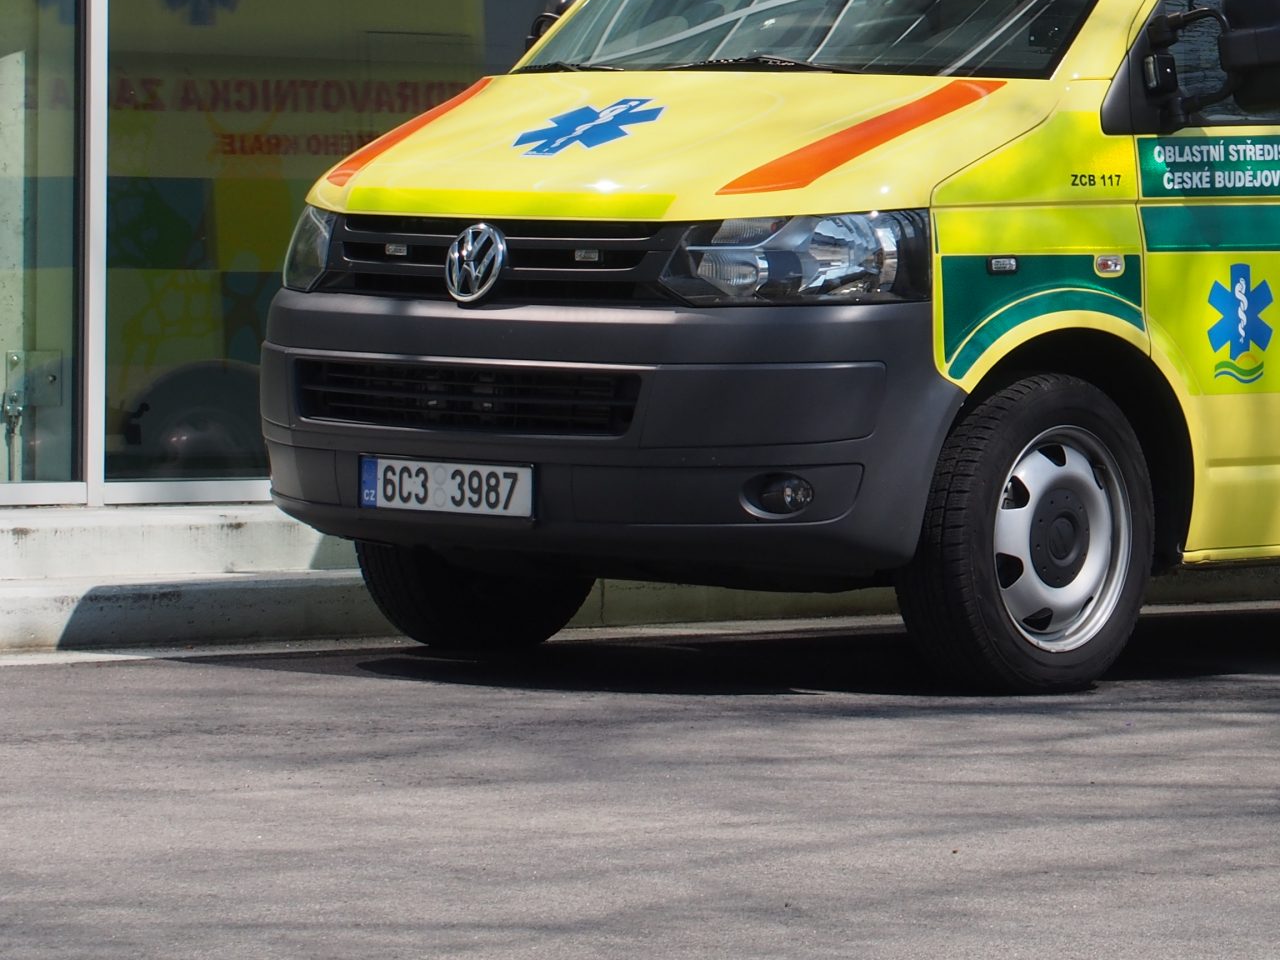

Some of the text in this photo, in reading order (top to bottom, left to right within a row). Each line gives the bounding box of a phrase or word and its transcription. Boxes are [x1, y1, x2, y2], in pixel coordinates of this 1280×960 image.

[1153, 141, 1225, 163] OBLASTNÍ
[1070, 174, 1122, 187] ZCB 117
[1163, 167, 1210, 189] ČESKÉ
[363, 490, 376, 502] CZ
[382, 465, 519, 511] 6C3 3987
